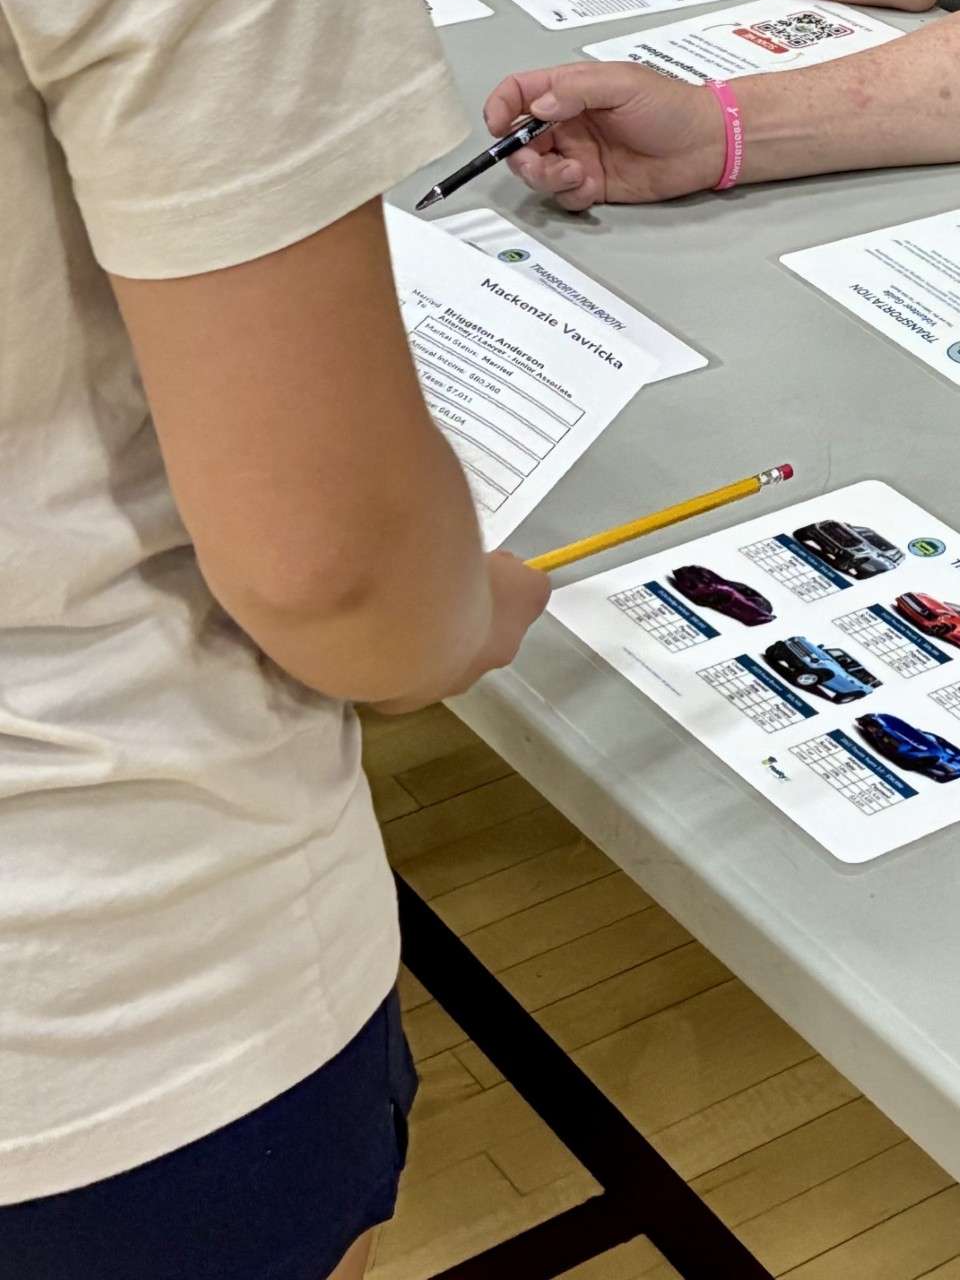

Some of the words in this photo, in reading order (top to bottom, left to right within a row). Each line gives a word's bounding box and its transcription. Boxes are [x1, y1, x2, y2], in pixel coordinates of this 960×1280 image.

[728, 119, 743, 180] Awareness
[480, 277, 559, 328] Mackenzie
[562, 322, 625, 371] Vavricka
[529, 263, 599, 315] TRANSPORTATION
[594, 308, 627, 331] BOOTH
[848, 283, 939, 344] TRANSPORTATION
[444, 307, 495, 341] Briggston
[495, 336, 545, 370] Anderson
[535, 372, 573, 400] Associate
